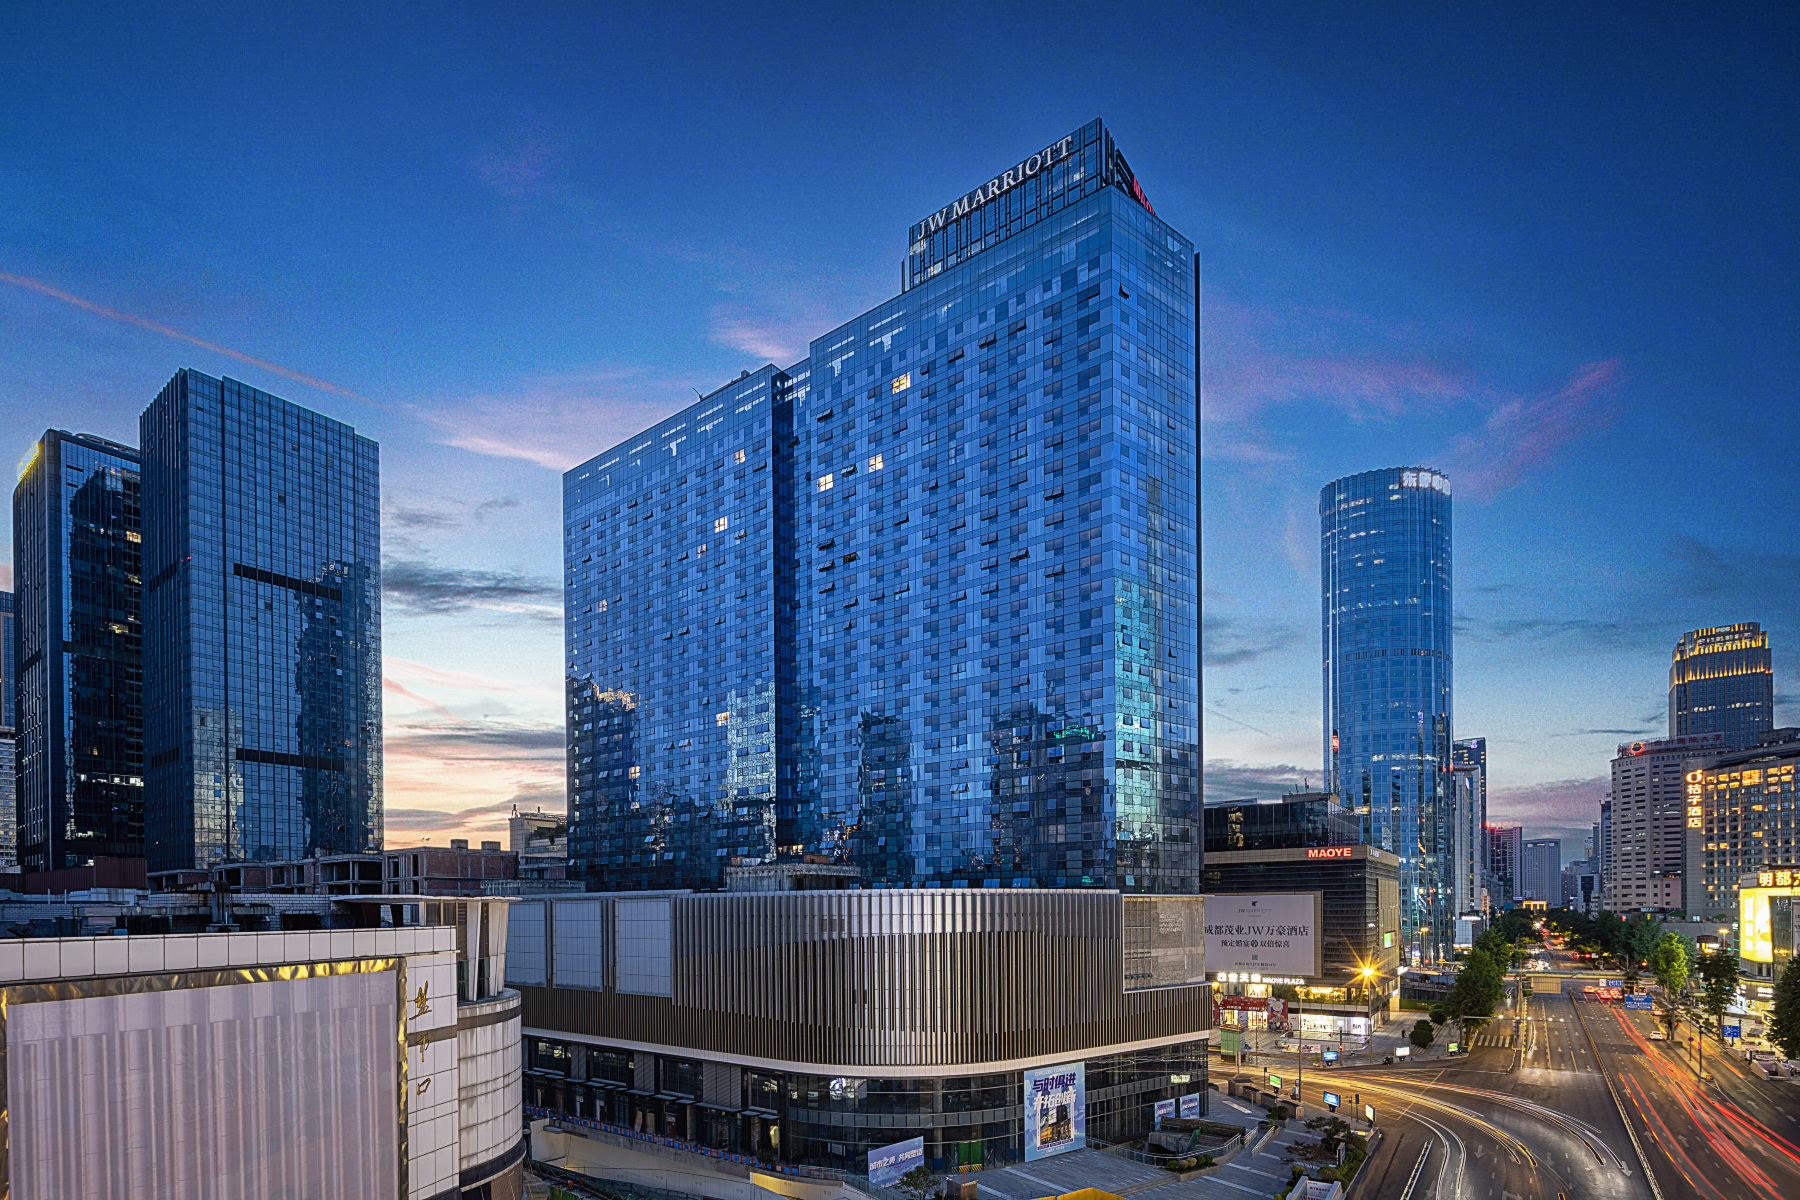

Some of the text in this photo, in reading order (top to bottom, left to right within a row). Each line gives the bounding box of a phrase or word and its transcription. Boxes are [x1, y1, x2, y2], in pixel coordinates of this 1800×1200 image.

[916, 134, 1074, 240] JW MARRIOTT
[1686, 784, 1703, 828] 桔子酒店
[1308, 847, 1352, 859] MAOYE
[1032, 1072, 1077, 1092] 与时俱进
[1033, 1086, 1077, 1111] 开拓创新
